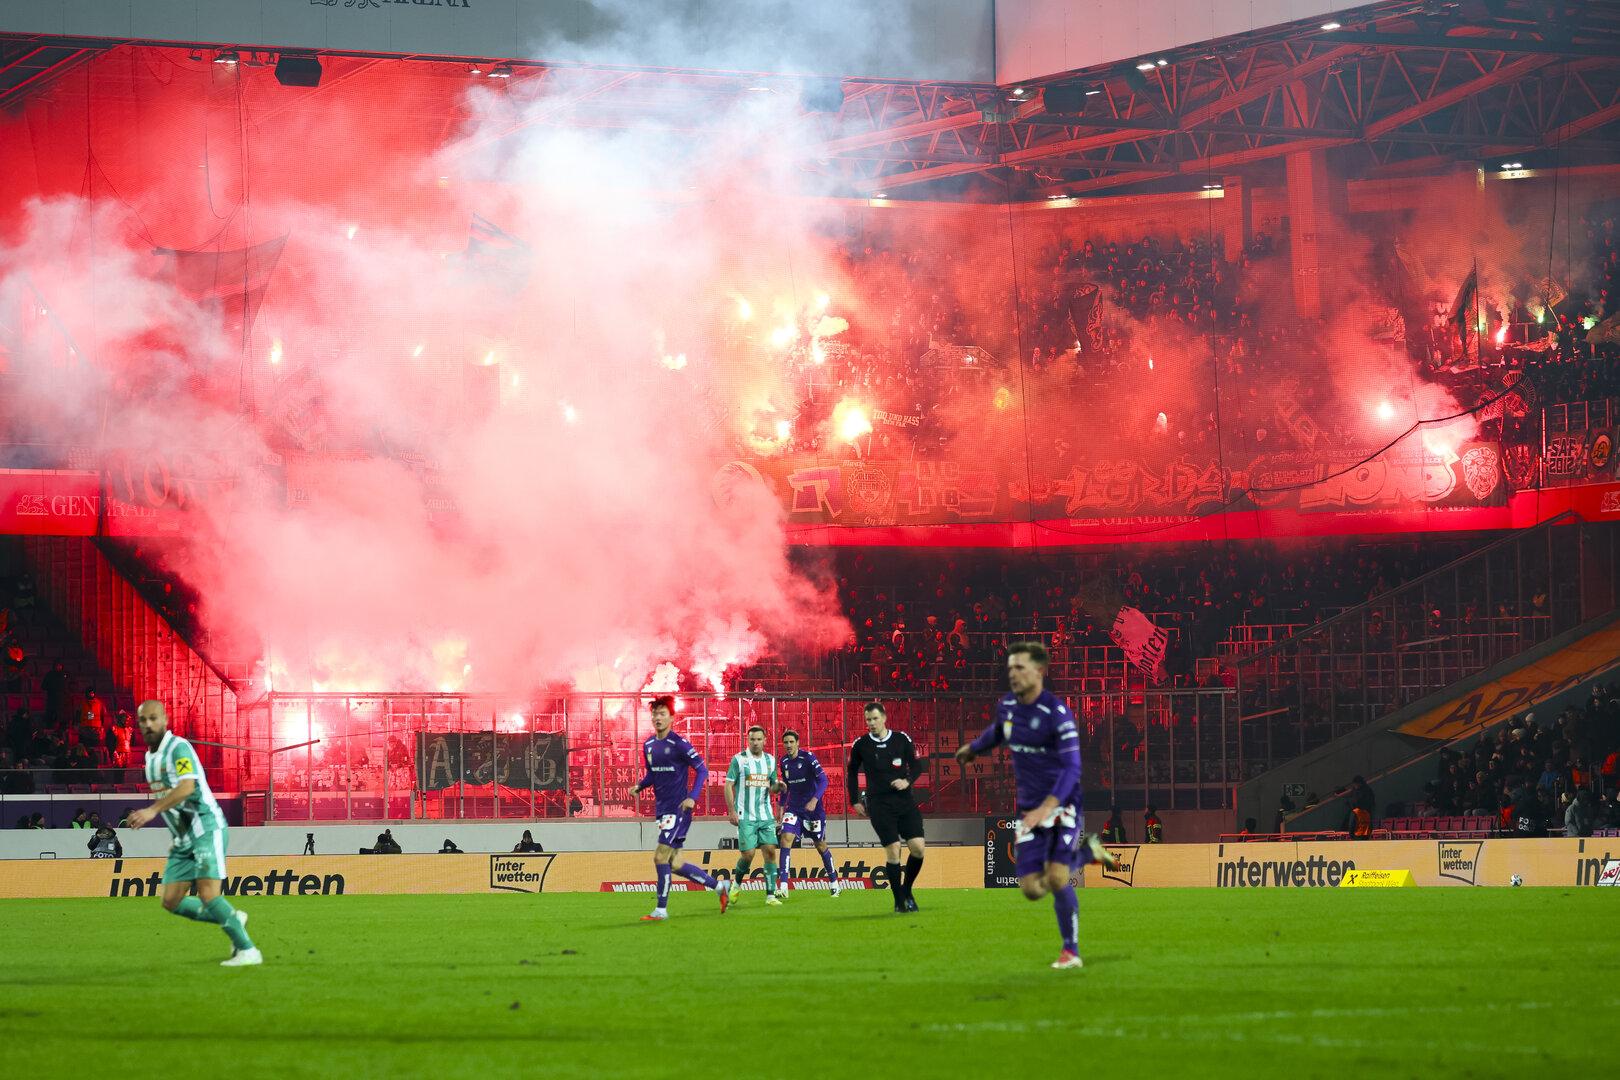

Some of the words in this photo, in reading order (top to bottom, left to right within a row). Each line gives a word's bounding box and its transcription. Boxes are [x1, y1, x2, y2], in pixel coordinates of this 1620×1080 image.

[750, 773, 768, 781] WIEN
[996, 819, 1018, 830] Gob
[986, 830, 996, 875] Gobatin
[1441, 843, 1462, 859] inter
[494, 855, 525, 872] inter
[1217, 844, 1356, 887] interwetten
[1443, 860, 1473, 871] wetten
[110, 859, 345, 897] intwetten
[496, 871, 540, 883] wetten
